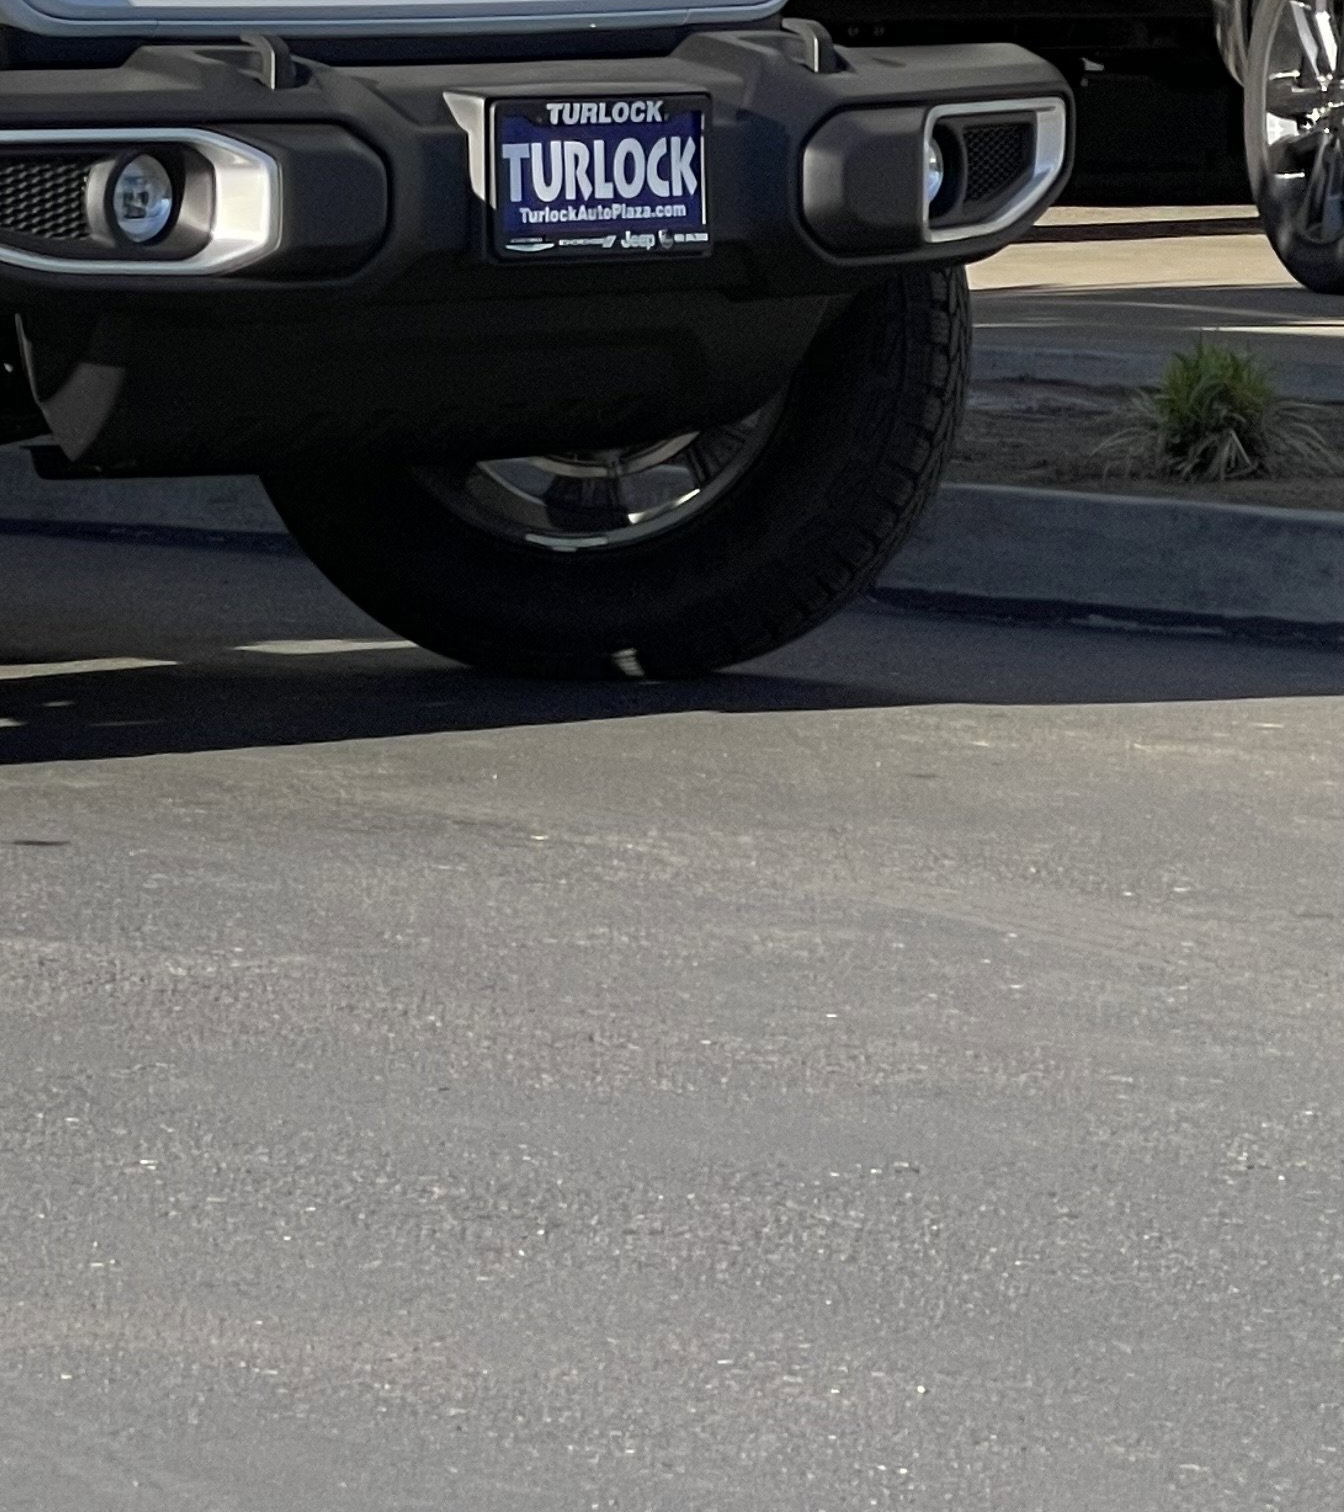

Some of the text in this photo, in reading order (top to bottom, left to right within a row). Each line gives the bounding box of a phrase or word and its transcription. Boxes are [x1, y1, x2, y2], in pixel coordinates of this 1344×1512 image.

[546, 100, 664, 125] TURLOCK
[501, 135, 698, 202] TURLOCK
[519, 203, 687, 223] TurlockAutoPlaza.com
